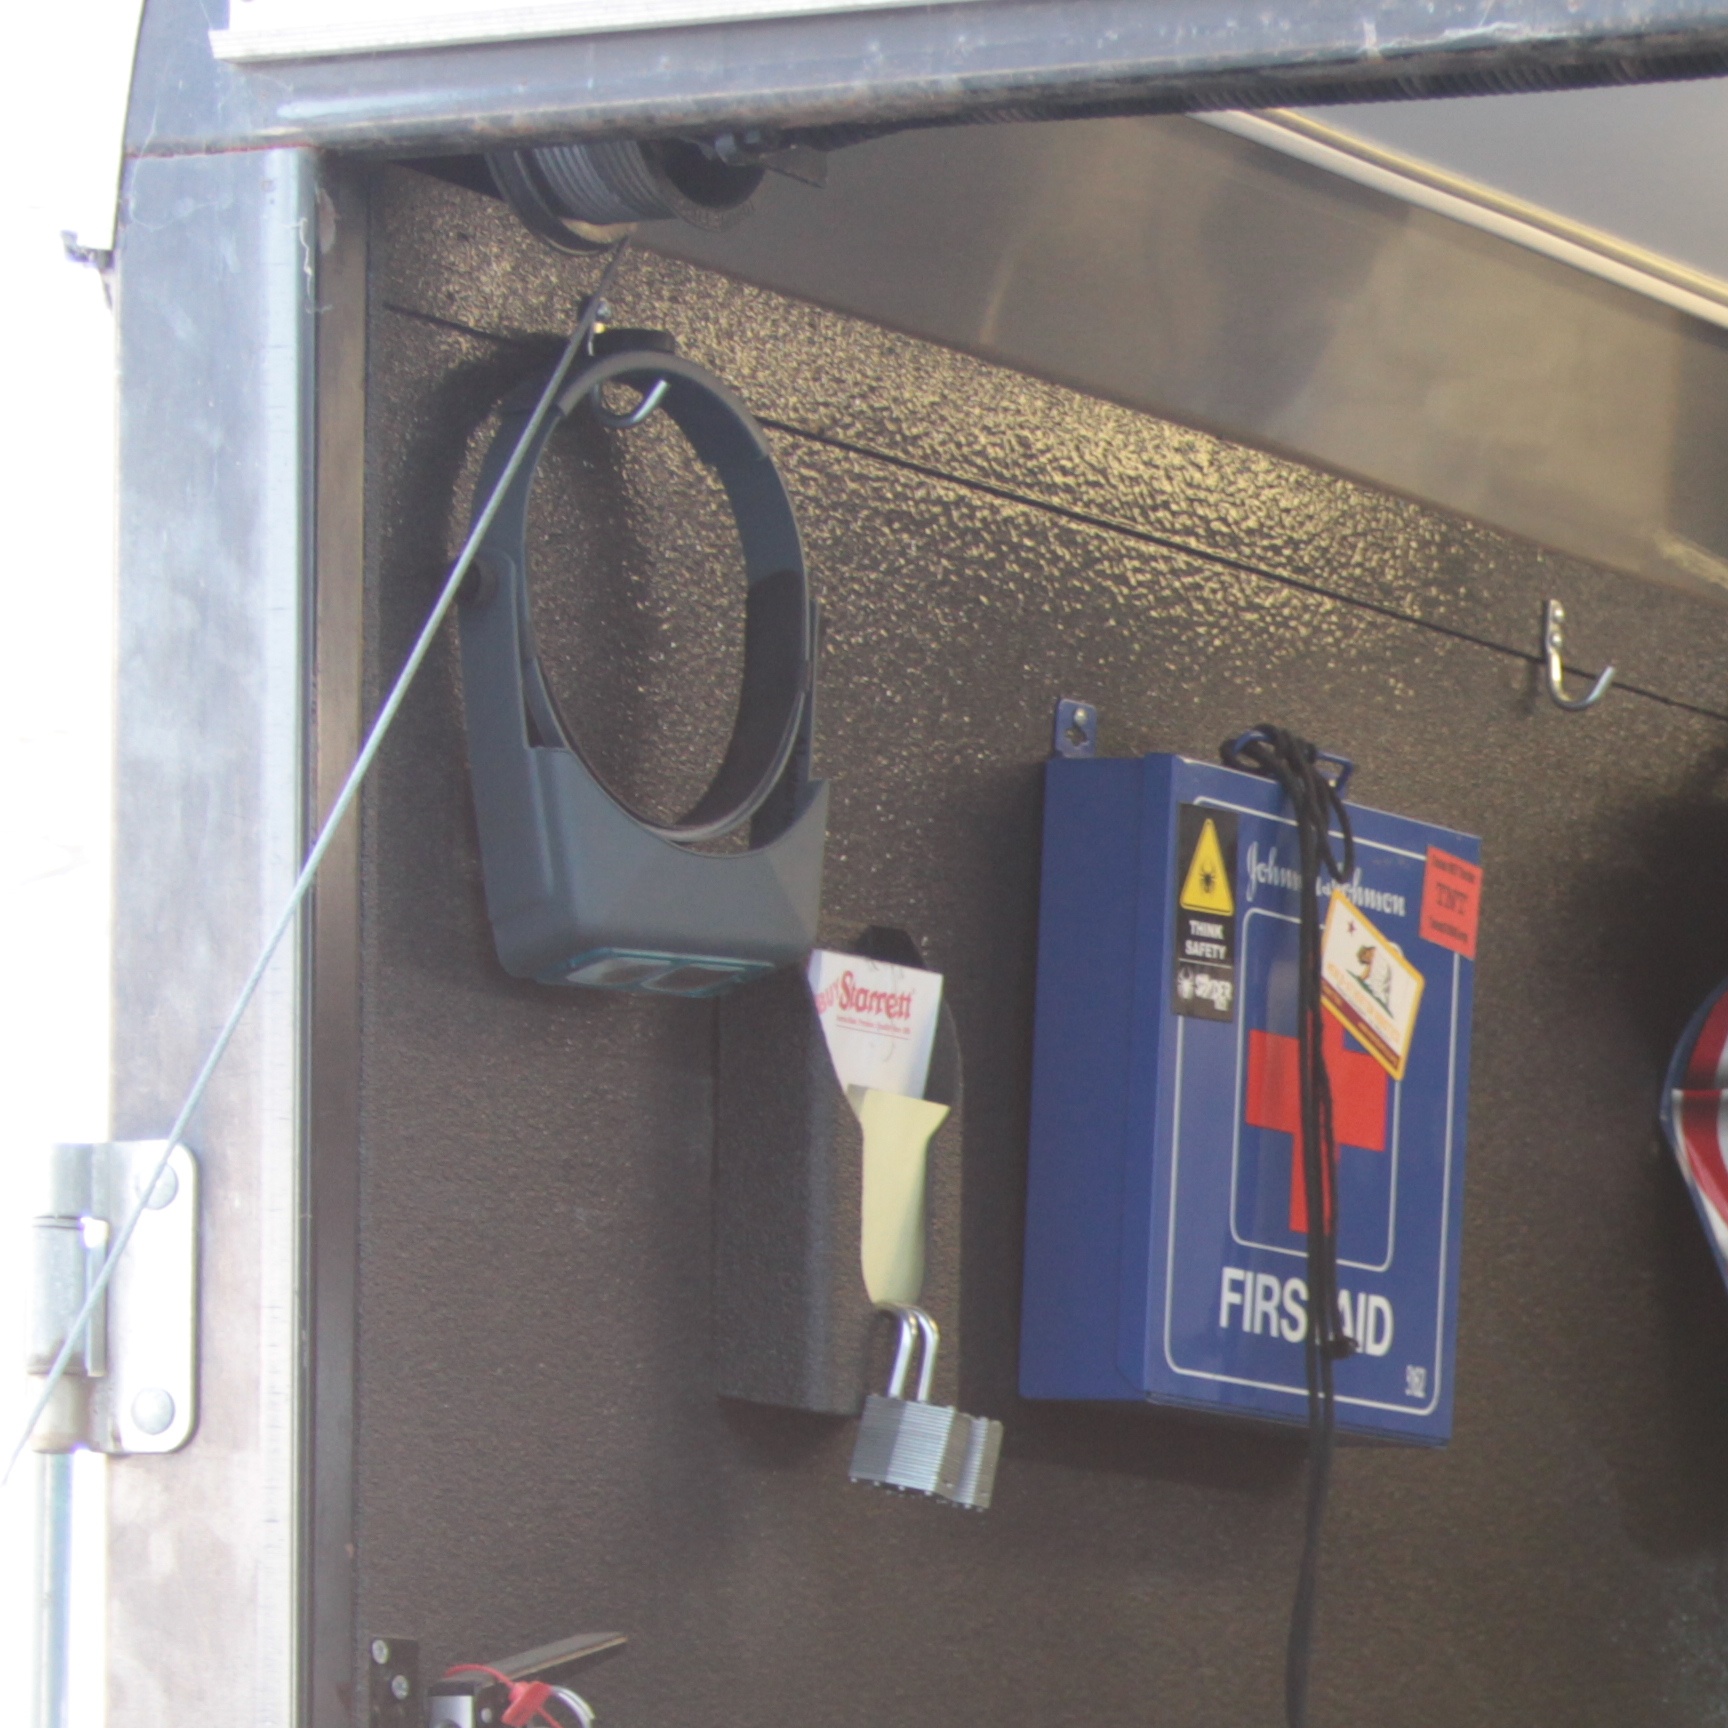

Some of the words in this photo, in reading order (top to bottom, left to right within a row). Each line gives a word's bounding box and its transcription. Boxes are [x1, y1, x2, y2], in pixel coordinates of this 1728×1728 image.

[1189, 919, 1225, 940] THINK
[1185, 940, 1227, 960] SAFETY
[838, 970, 913, 1020] Starrett
[1219, 1266, 1322, 1346] FIRS
